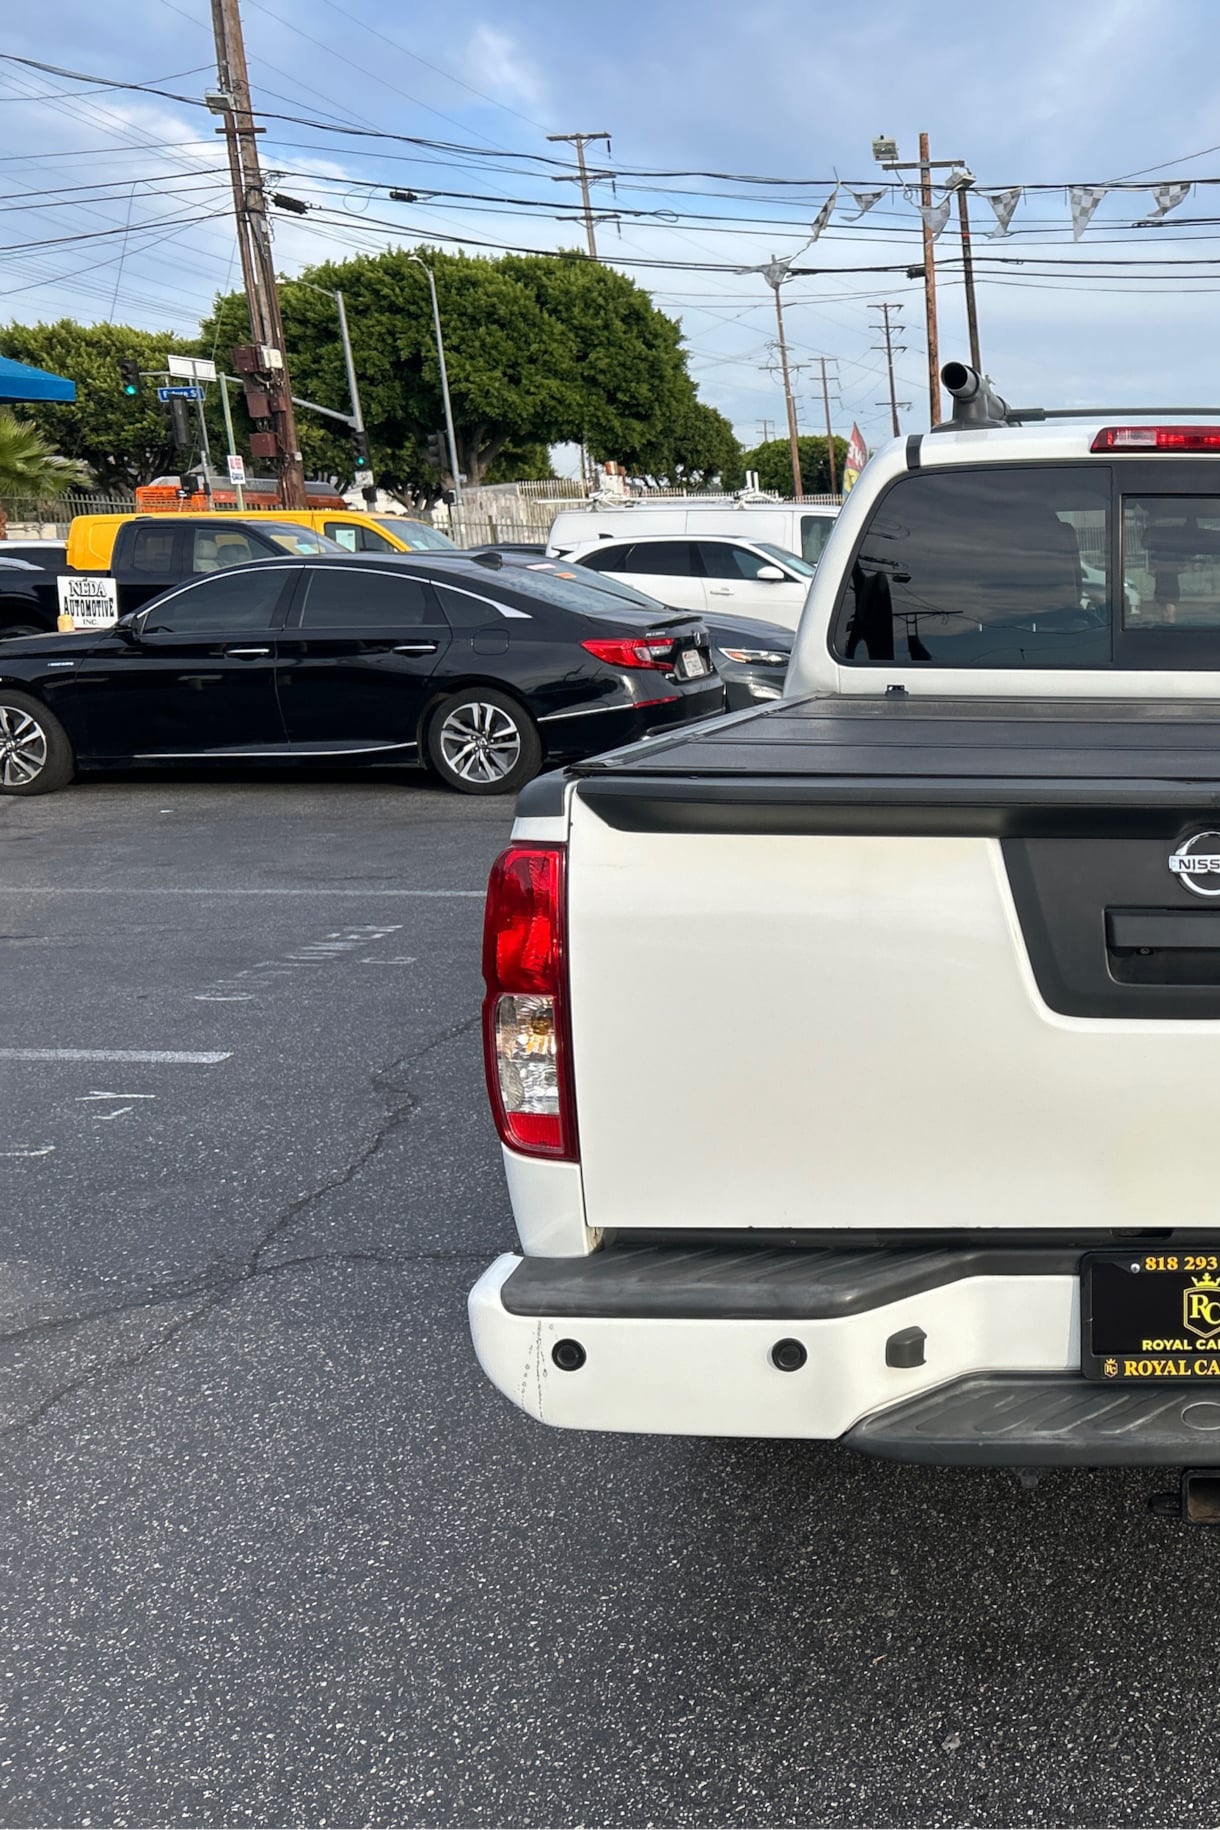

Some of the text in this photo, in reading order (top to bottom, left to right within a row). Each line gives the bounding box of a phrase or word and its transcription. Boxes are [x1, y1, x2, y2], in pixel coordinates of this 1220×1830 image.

[64, 596, 115, 618] AUTOMOTIVE
[1145, 1256, 1179, 1271] 818
[1184, 1256, 1218, 1271] 293
[1142, 1339, 1193, 1351] ROYAL
[1123, 1360, 1192, 1376] ROYAL
